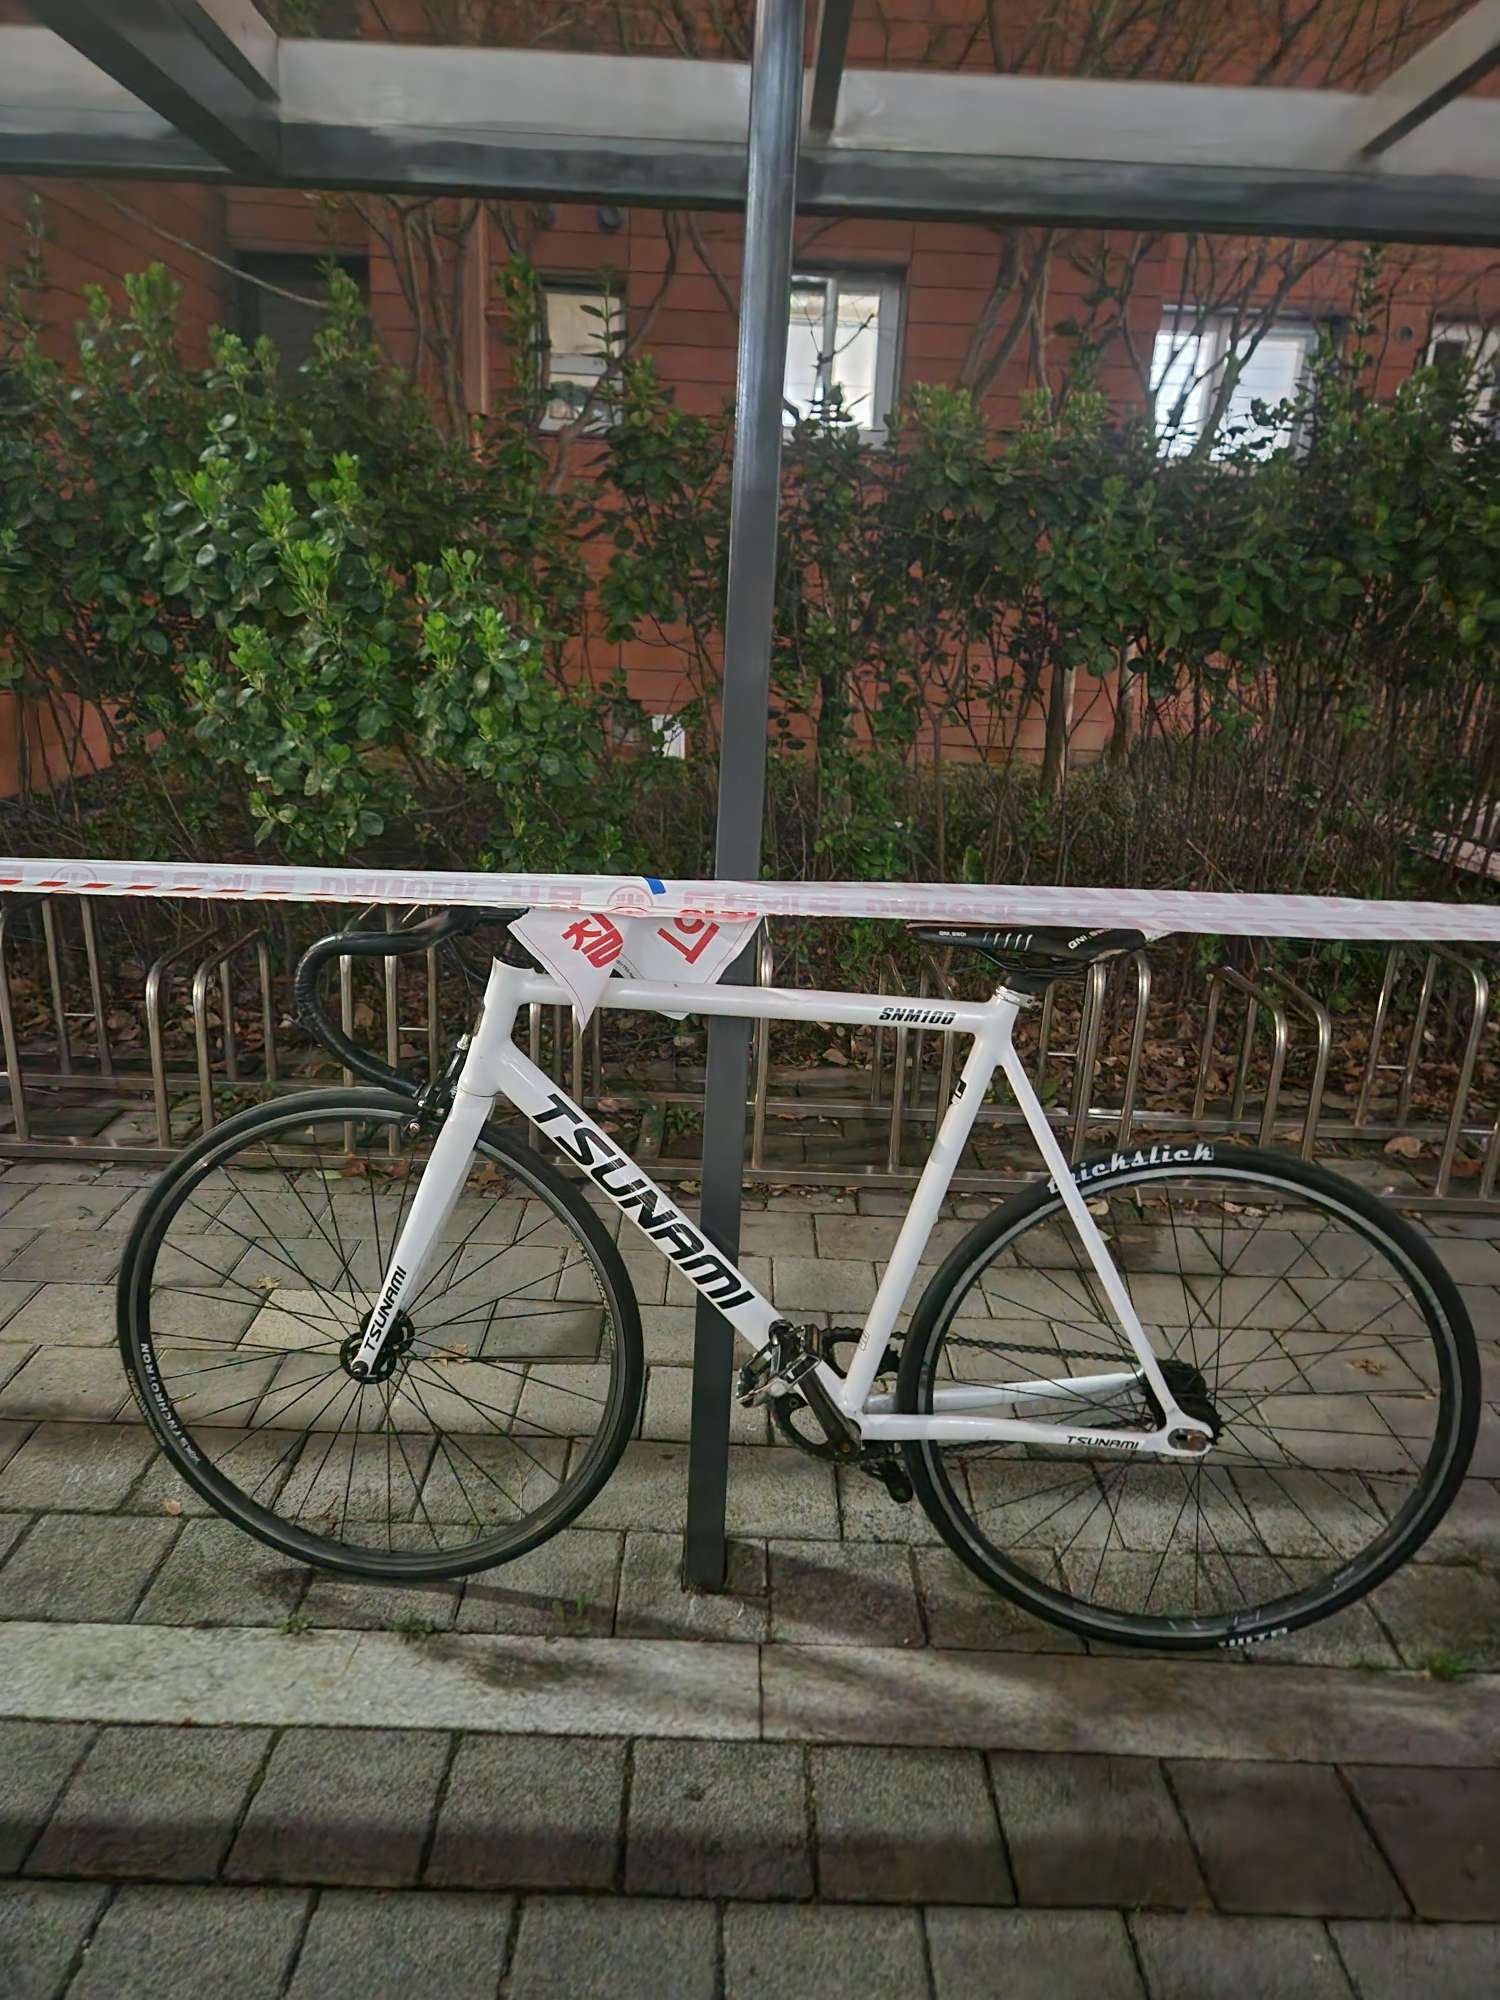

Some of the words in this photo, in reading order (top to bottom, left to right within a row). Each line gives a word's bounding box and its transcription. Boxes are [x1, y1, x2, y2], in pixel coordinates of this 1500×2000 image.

[878, 1007, 957, 1025] SNM100
[531, 1093, 755, 1310] TSUNAMI
[364, 1265, 407, 1351] TSUNAMI
[1066, 1435, 1140, 1450] TSUNAMI
